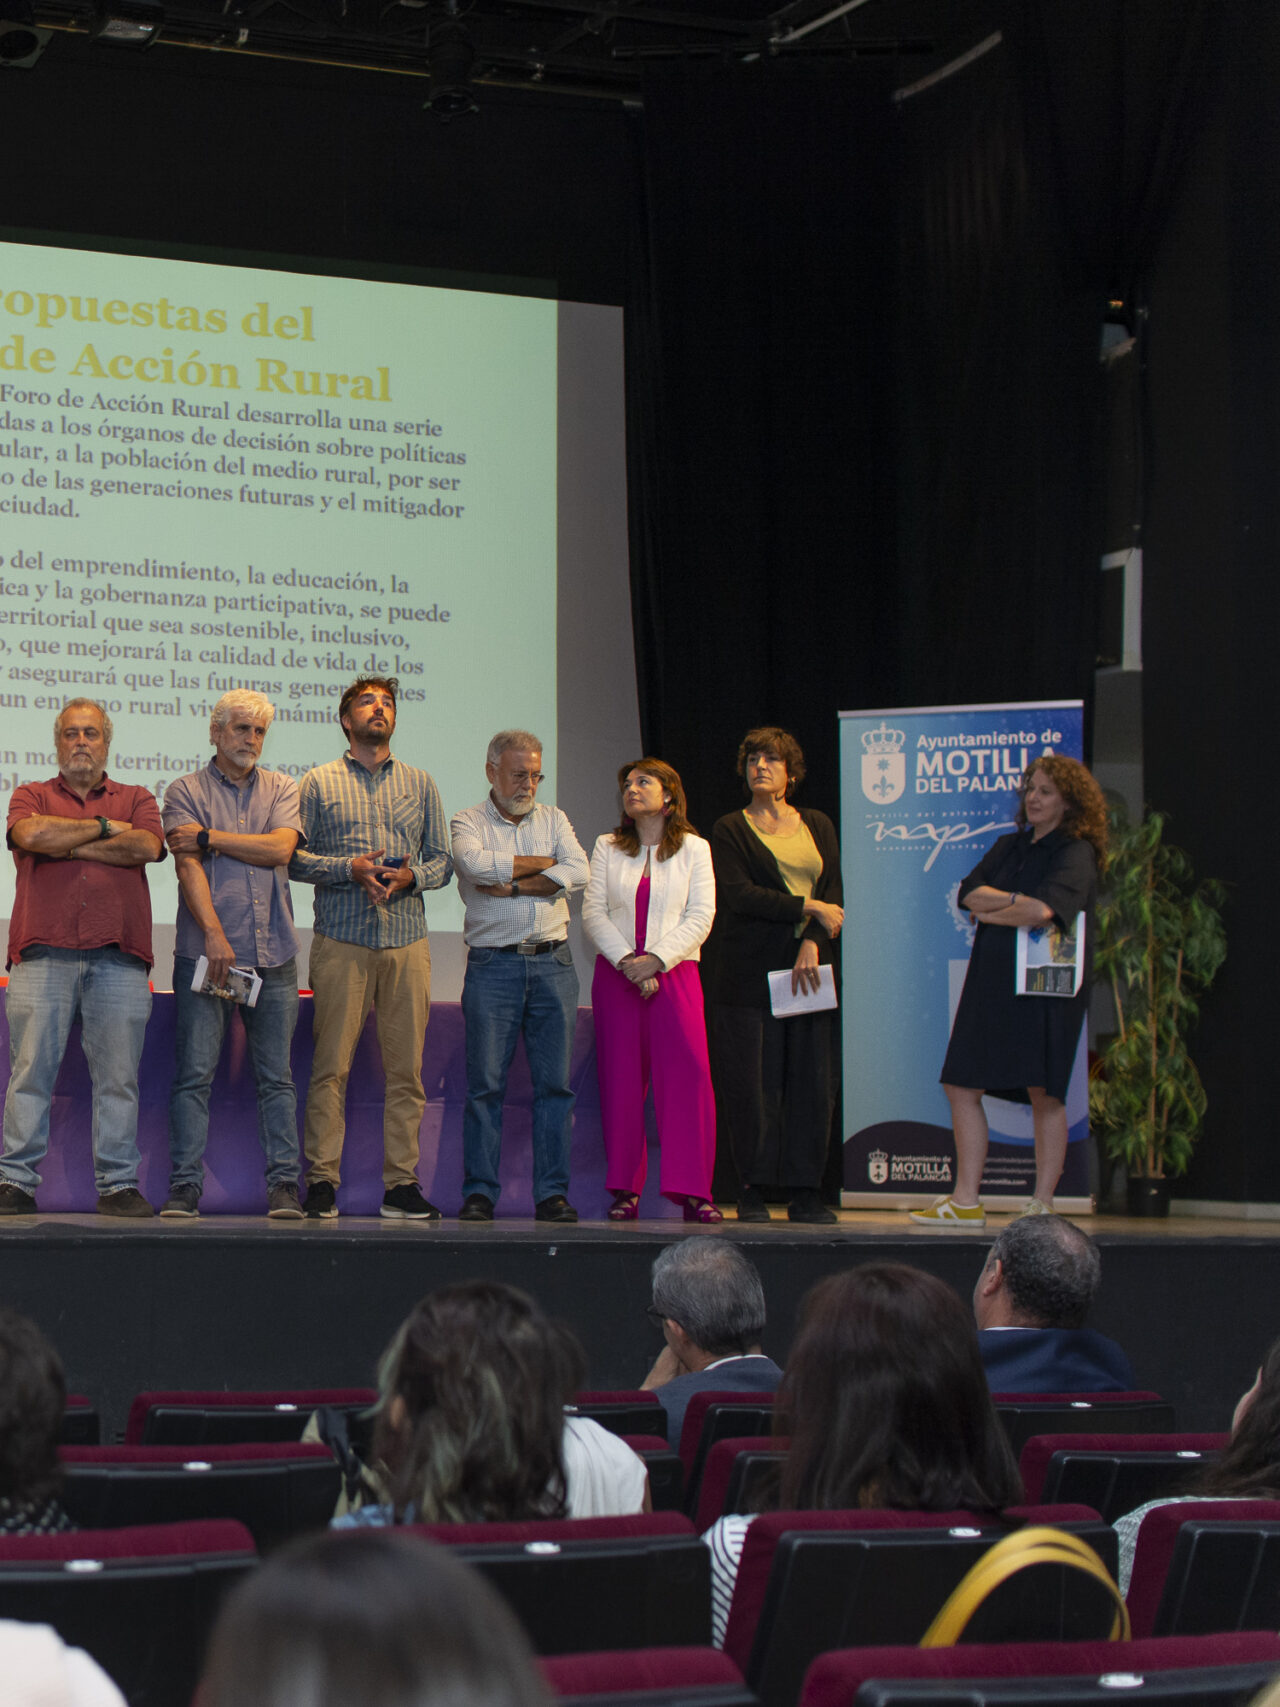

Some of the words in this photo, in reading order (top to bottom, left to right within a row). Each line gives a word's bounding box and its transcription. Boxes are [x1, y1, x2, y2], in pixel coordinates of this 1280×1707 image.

[240, 302, 316, 341] del
[70, 343, 240, 389] Acción
[255, 357, 392, 401] Rural
[0, 383, 52, 406] Foro
[56, 387, 85, 408] de
[89, 392, 164, 415] Acción
[171, 398, 230, 420] Rural
[236, 402, 343, 430] desarrolla
[348, 417, 388, 433] una
[393, 418, 443, 437] serie
[40, 420, 54, 434] a
[60, 414, 92, 436] los
[97, 418, 185, 444] órganos
[191, 426, 217, 446] de
[222, 428, 311, 453] decisión
[315, 437, 375, 458] sobre
[379, 442, 467, 465] políticas
[55, 448, 69, 462] a
[75, 443, 94, 464] la
[100, 447, 208, 473] población
[212, 454, 246, 476] del
[252, 459, 319, 481] medio
[324, 466, 382, 489] rural,
[388, 473, 425, 492] por
[428, 477, 462, 491] ser
[20, 467, 48, 488] de
[55, 470, 85, 490] las
[89, 479, 234, 502] generaciones
[239, 484, 315, 507] futuras
[319, 495, 334, 513] y
[337, 491, 356, 511] el
[362, 495, 466, 520] mitigador
[9, 550, 44, 571] del
[50, 558, 241, 587] emprendimiento,
[248, 564, 266, 585] la
[271, 567, 385, 595] educación,
[391, 574, 410, 594] la
[34, 584, 49, 603] y
[55, 579, 74, 599] la
[79, 583, 207, 608] gobernanza
[213, 593, 355, 620] participativa,
[359, 605, 382, 619] se
[388, 603, 451, 625] puede
[102, 617, 144, 635] que
[148, 620, 184, 634] sea
[189, 620, 305, 645] sostenible,
[311, 623, 411, 651] inclusivo,
[18, 640, 61, 658] que
[67, 639, 167, 662] mejorará
[173, 642, 193, 662] la
[198, 644, 277, 667] calidad
[280, 648, 308, 669] de
[312, 651, 357, 672] vida
[361, 652, 390, 672] de
[394, 654, 424, 675] los
[7, 665, 117, 687] asegurará
[123, 674, 165, 691] que
[170, 669, 201, 689] las
[207, 671, 283, 694] futuras
[0, 693, 27, 708] un
[128, 697, 181, 716] rural
[917, 731, 1037, 750] Ayuntamiento
[1041, 728, 1062, 744] de
[916, 777, 952, 794] DEL
[957, 775, 1022, 793] PALAN
[891, 1162, 951, 1174] MOTILLA
